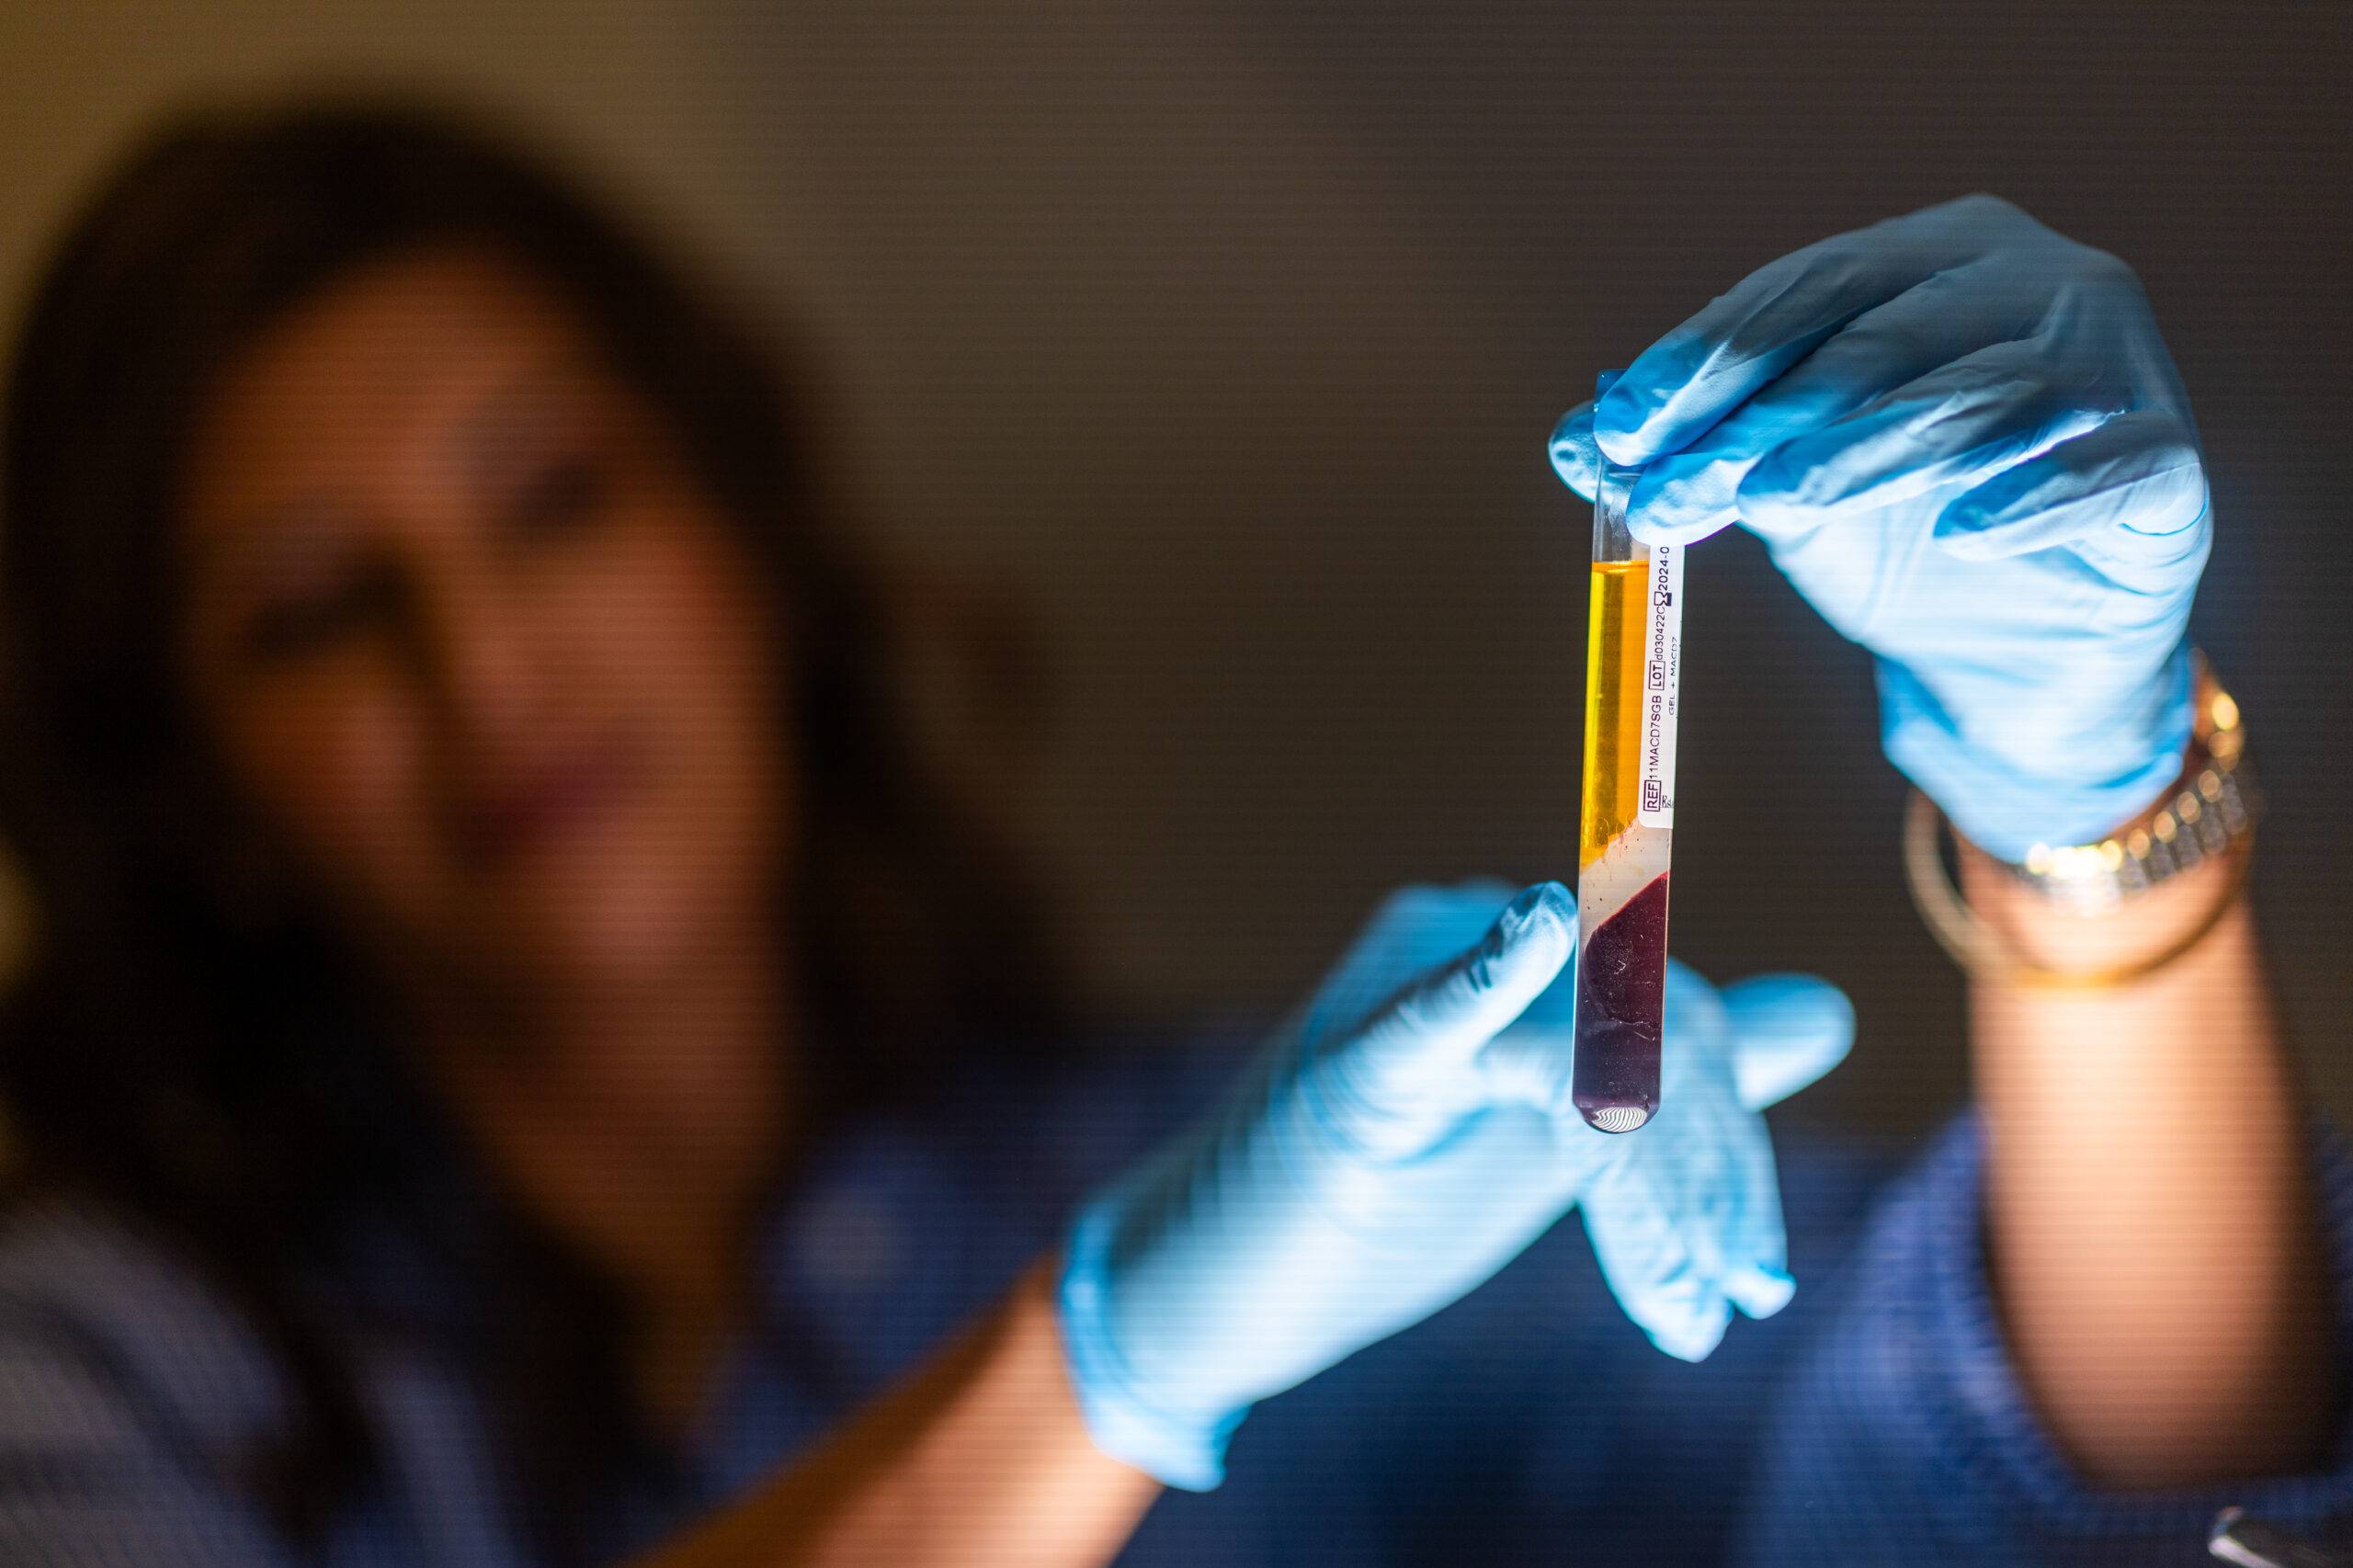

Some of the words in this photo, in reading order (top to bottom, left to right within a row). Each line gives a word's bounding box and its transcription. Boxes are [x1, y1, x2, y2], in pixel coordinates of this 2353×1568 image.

[1658, 546, 1669, 592] 2024-0
[1652, 664, 1662, 687] LOT
[1649, 696, 1662, 779] 11MACD7SGB
[1647, 783, 1658, 809] REF
